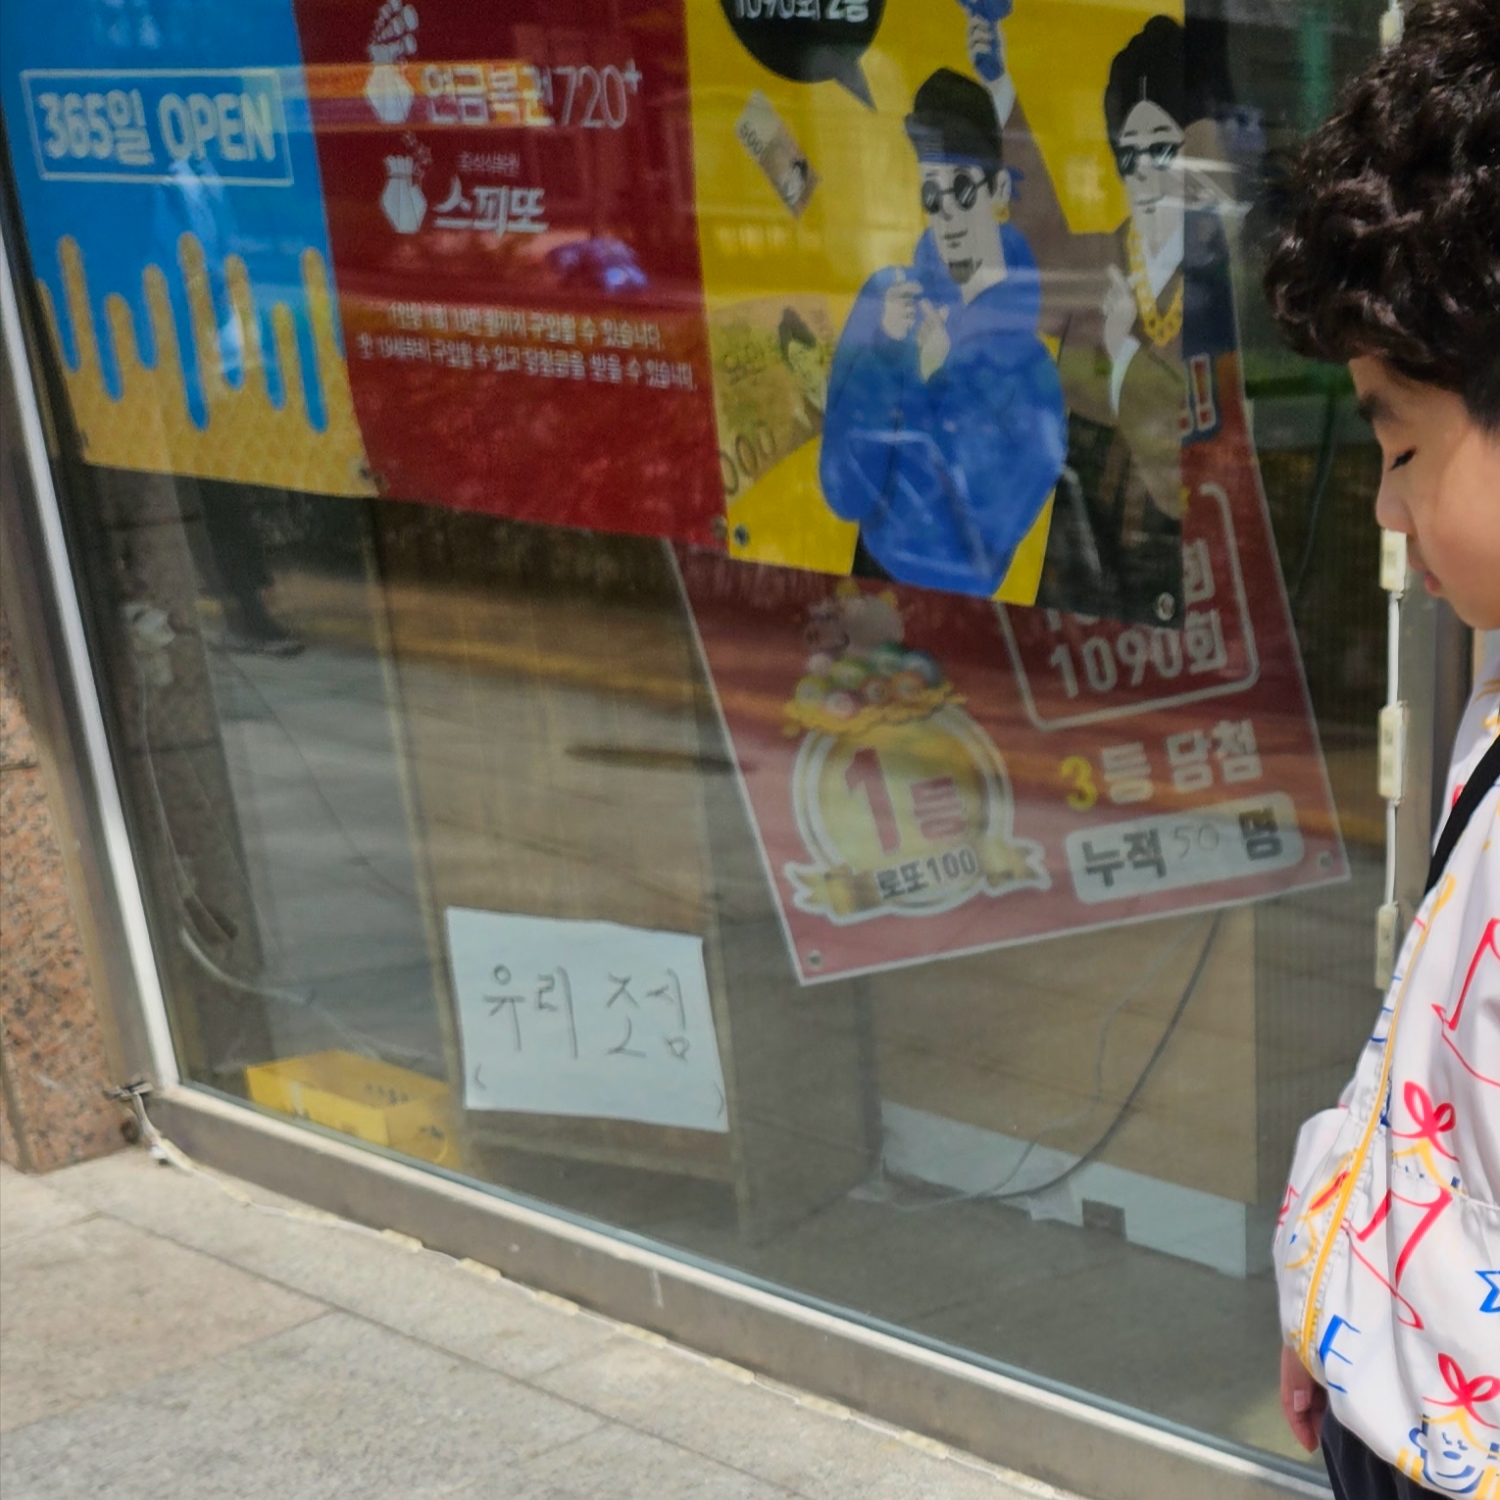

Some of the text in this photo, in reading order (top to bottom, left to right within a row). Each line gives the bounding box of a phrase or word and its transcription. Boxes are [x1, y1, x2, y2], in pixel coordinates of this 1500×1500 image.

[39, 92, 277, 165] 365일 OPEN
[433, 173, 549, 238] 스피또
[1050, 609, 1229, 699] 1090회
[1166, 719, 1264, 793] 당첨
[843, 748, 968, 855] 1등
[875, 846, 980, 898] 로또100
[1081, 826, 1168, 888] 누적
[1238, 806, 1284, 861] 명
